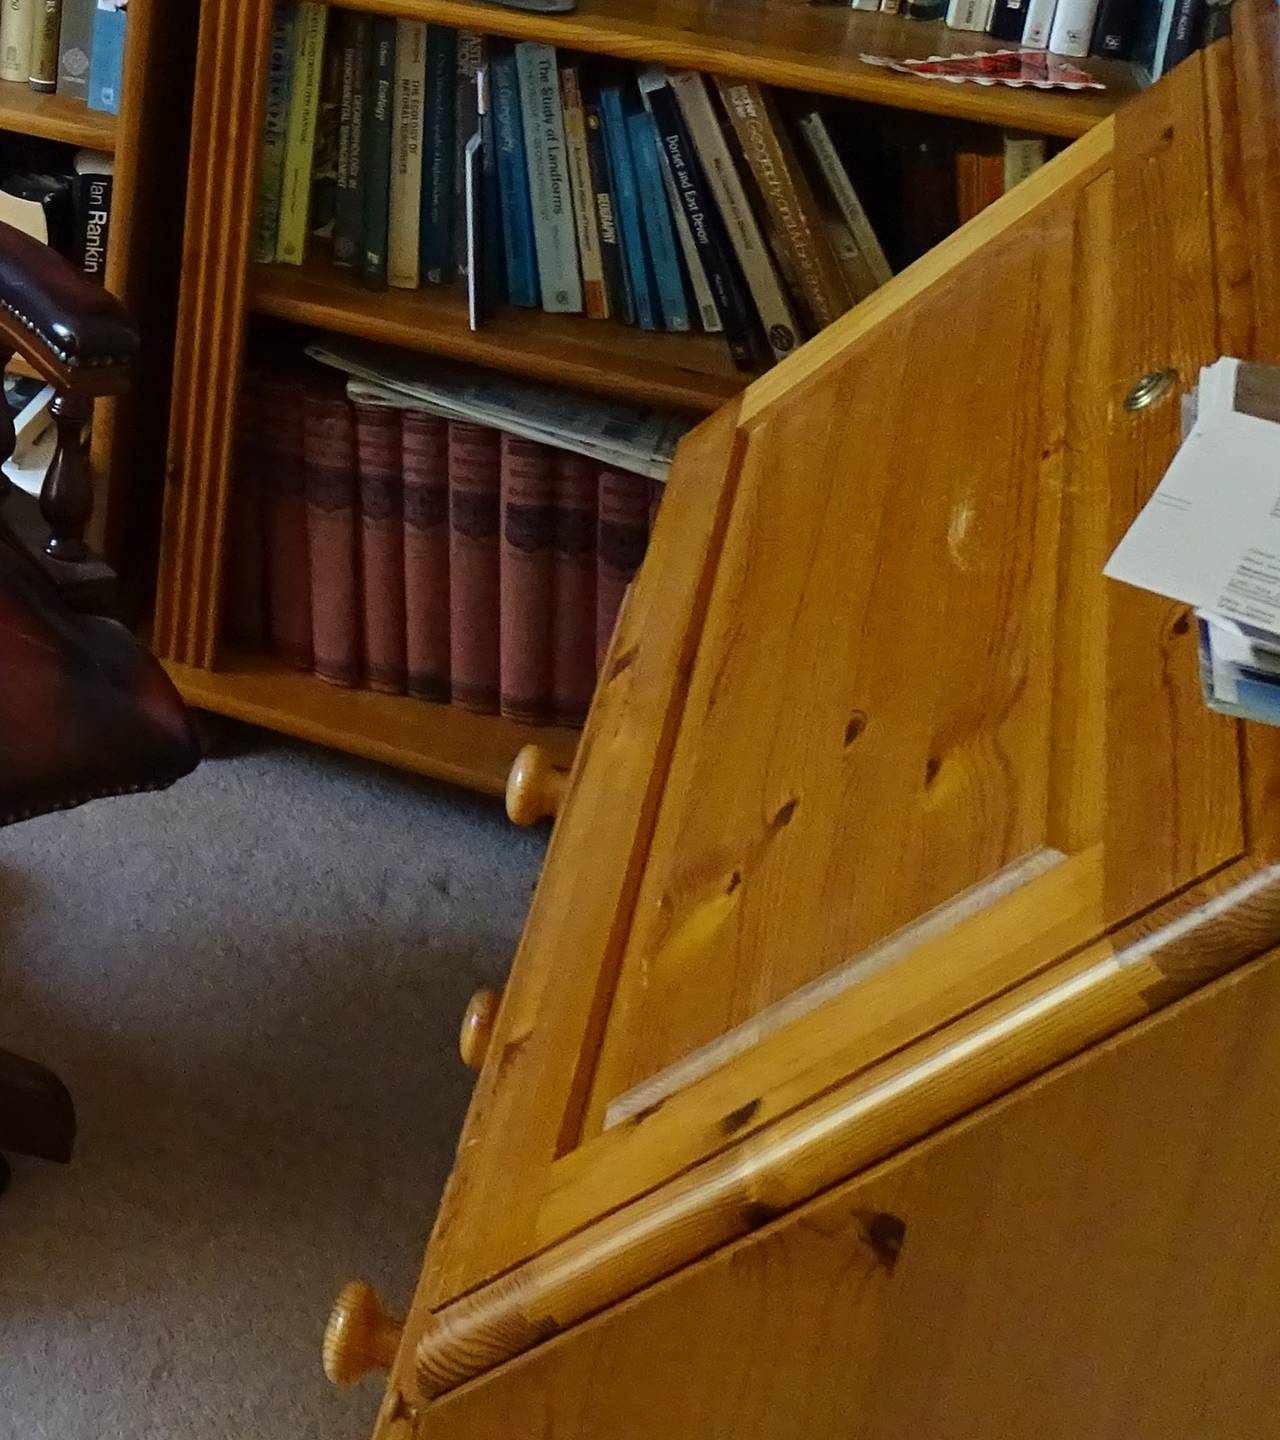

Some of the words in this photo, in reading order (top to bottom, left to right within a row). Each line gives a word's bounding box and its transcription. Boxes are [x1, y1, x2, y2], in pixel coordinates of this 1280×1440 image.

[540, 86, 555, 125] Study
[89, 180, 107, 205] Ian
[546, 146, 563, 215] Landforms
[666, 134, 688, 167] Dorset
[692, 212, 713, 245] Devon
[82, 210, 107, 273] Rankin
[596, 192, 615, 245] GEOGRAPHY
